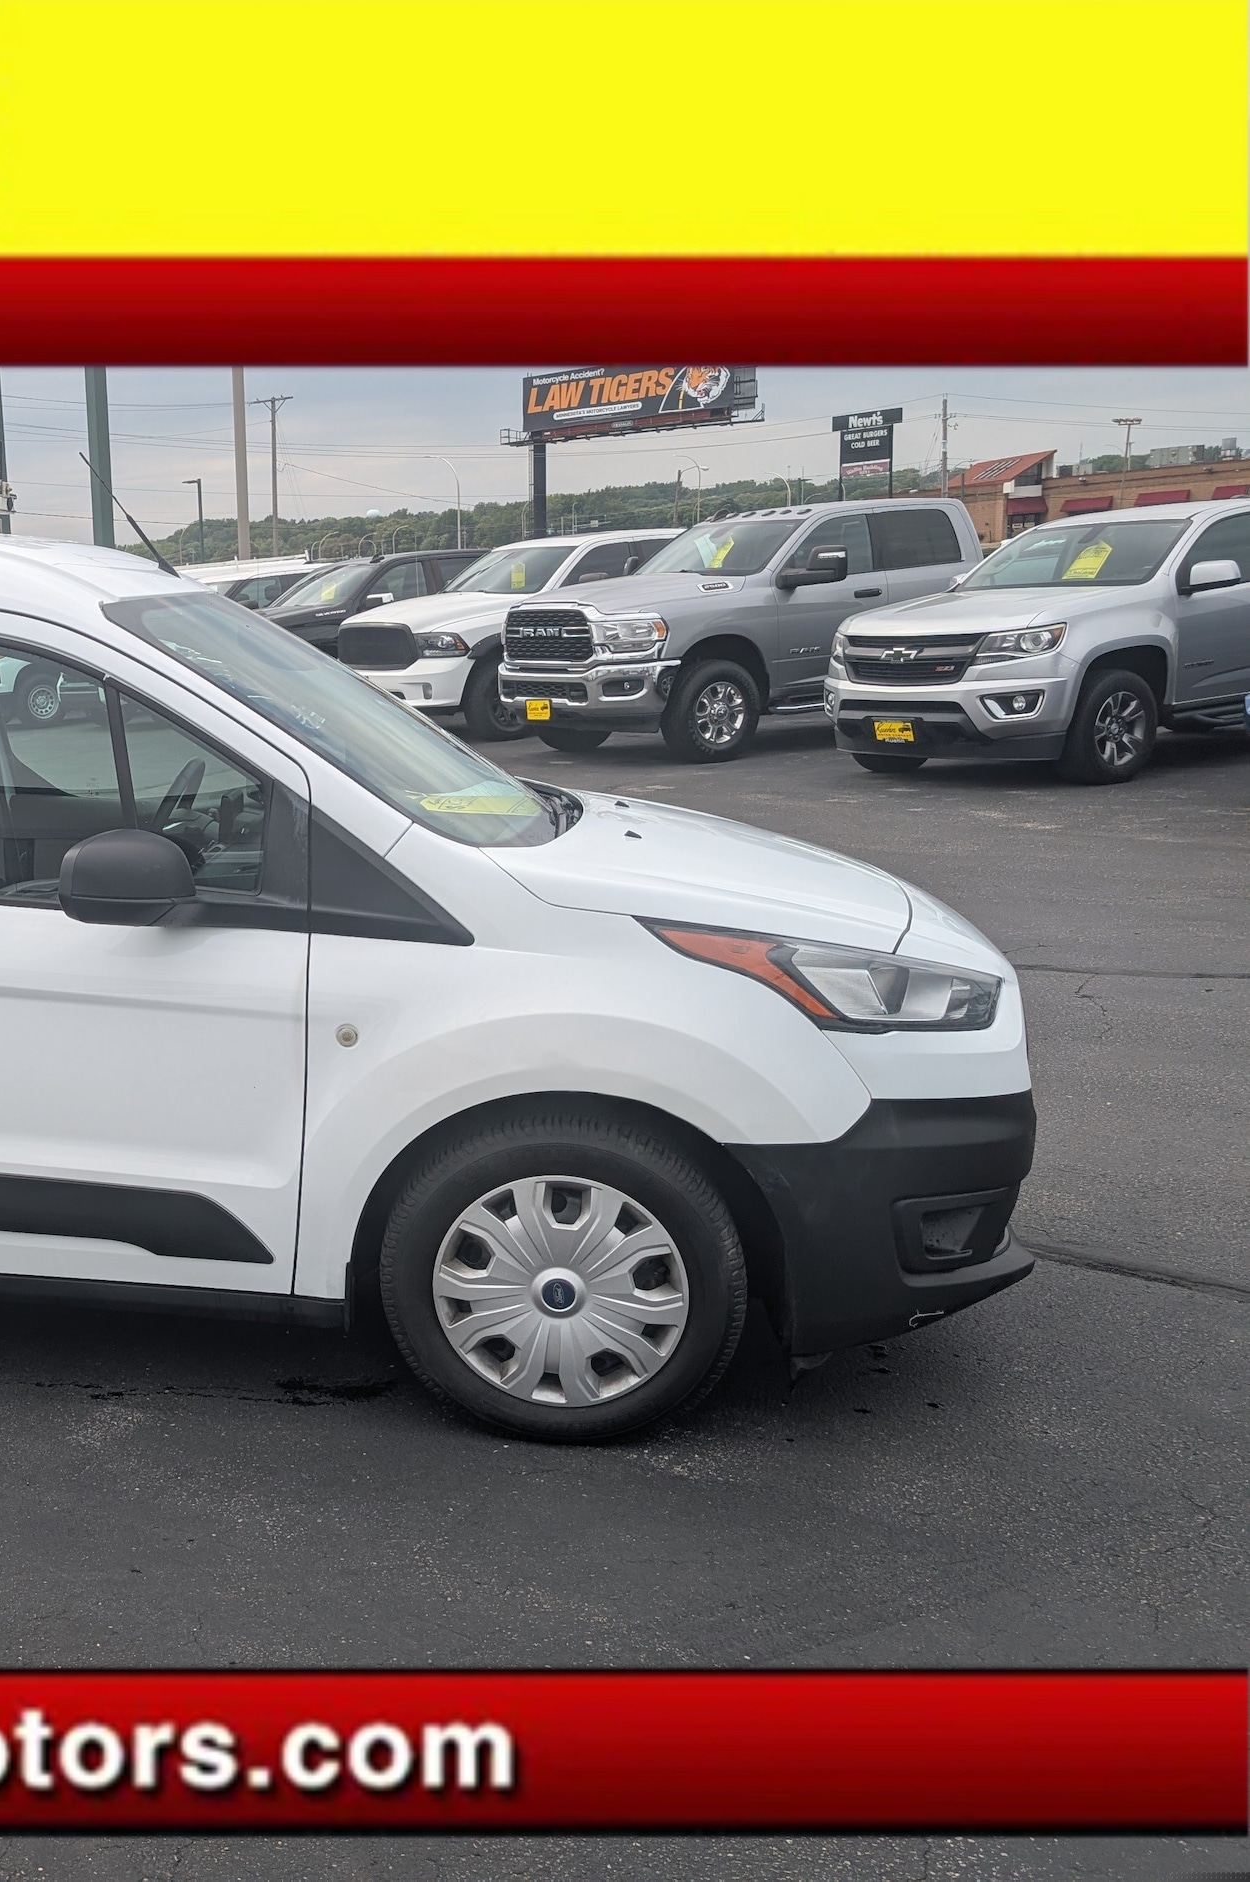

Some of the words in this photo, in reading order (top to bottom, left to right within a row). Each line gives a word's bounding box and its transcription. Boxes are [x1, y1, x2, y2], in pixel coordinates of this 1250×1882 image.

[532, 374, 569, 386] Motorcycle
[570, 368, 605, 380] Accident?
[527, 380, 585, 414] LAW
[589, 366, 675, 405] TIGERS
[586, 406, 617, 415] MOTORCYCLE
[848, 411, 883, 428] Newt's
[844, 432, 861, 441] GREAT
[863, 429, 888, 439] BURGERS
[850, 441, 866, 449] COLD
[867, 439, 880, 448] BEER
[523, 628, 559, 637] RAM
